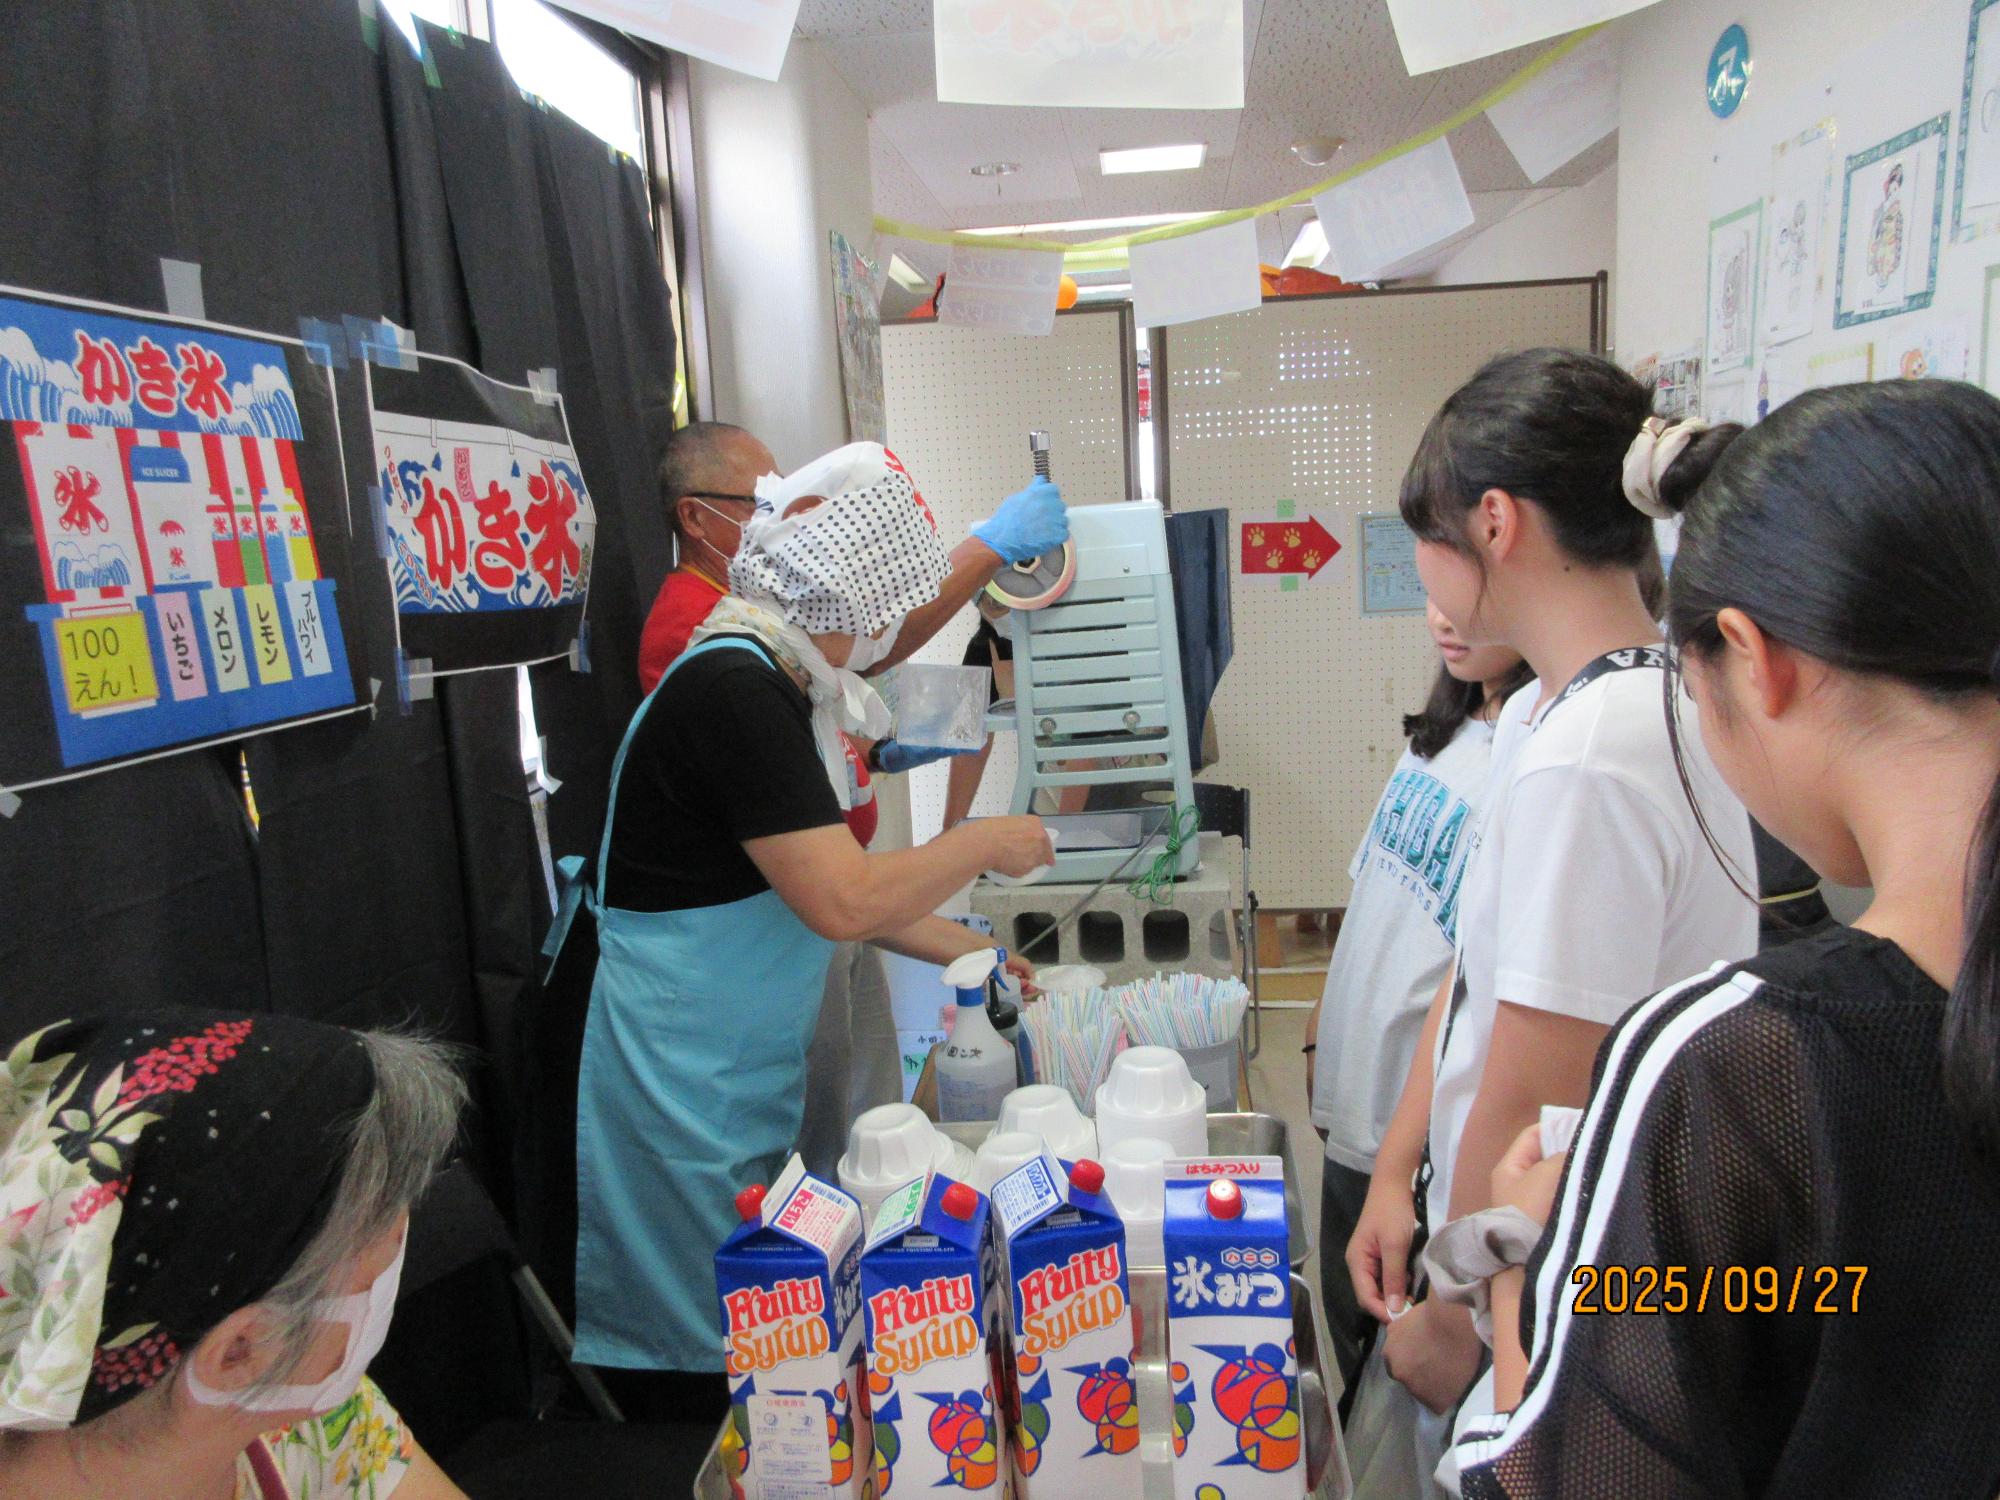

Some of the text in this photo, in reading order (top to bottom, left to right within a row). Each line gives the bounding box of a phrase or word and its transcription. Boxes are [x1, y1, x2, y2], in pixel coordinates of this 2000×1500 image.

[74, 331, 233, 418] かき氷
[54, 465, 108, 535] 氷
[414, 459, 581, 599] かき氷
[66, 626, 120, 661] 100
[165, 611, 195, 682] いちご
[213, 605, 236, 674] メロン
[256, 602, 279, 666] レモン
[1185, 1163, 1261, 1175] はちみつ入り
[1018, 1243, 1120, 1318] Fruity
[1172, 1256, 1285, 1308] 氷みつ
[1225, 1251, 1275, 1265] ハニー
[726, 1275, 825, 1333] Fruity
[870, 1274, 974, 1335] Fruity
[1022, 1284, 1124, 1356] Syrup
[729, 1315, 829, 1373] Syrup
[874, 1315, 978, 1375] Syrup
